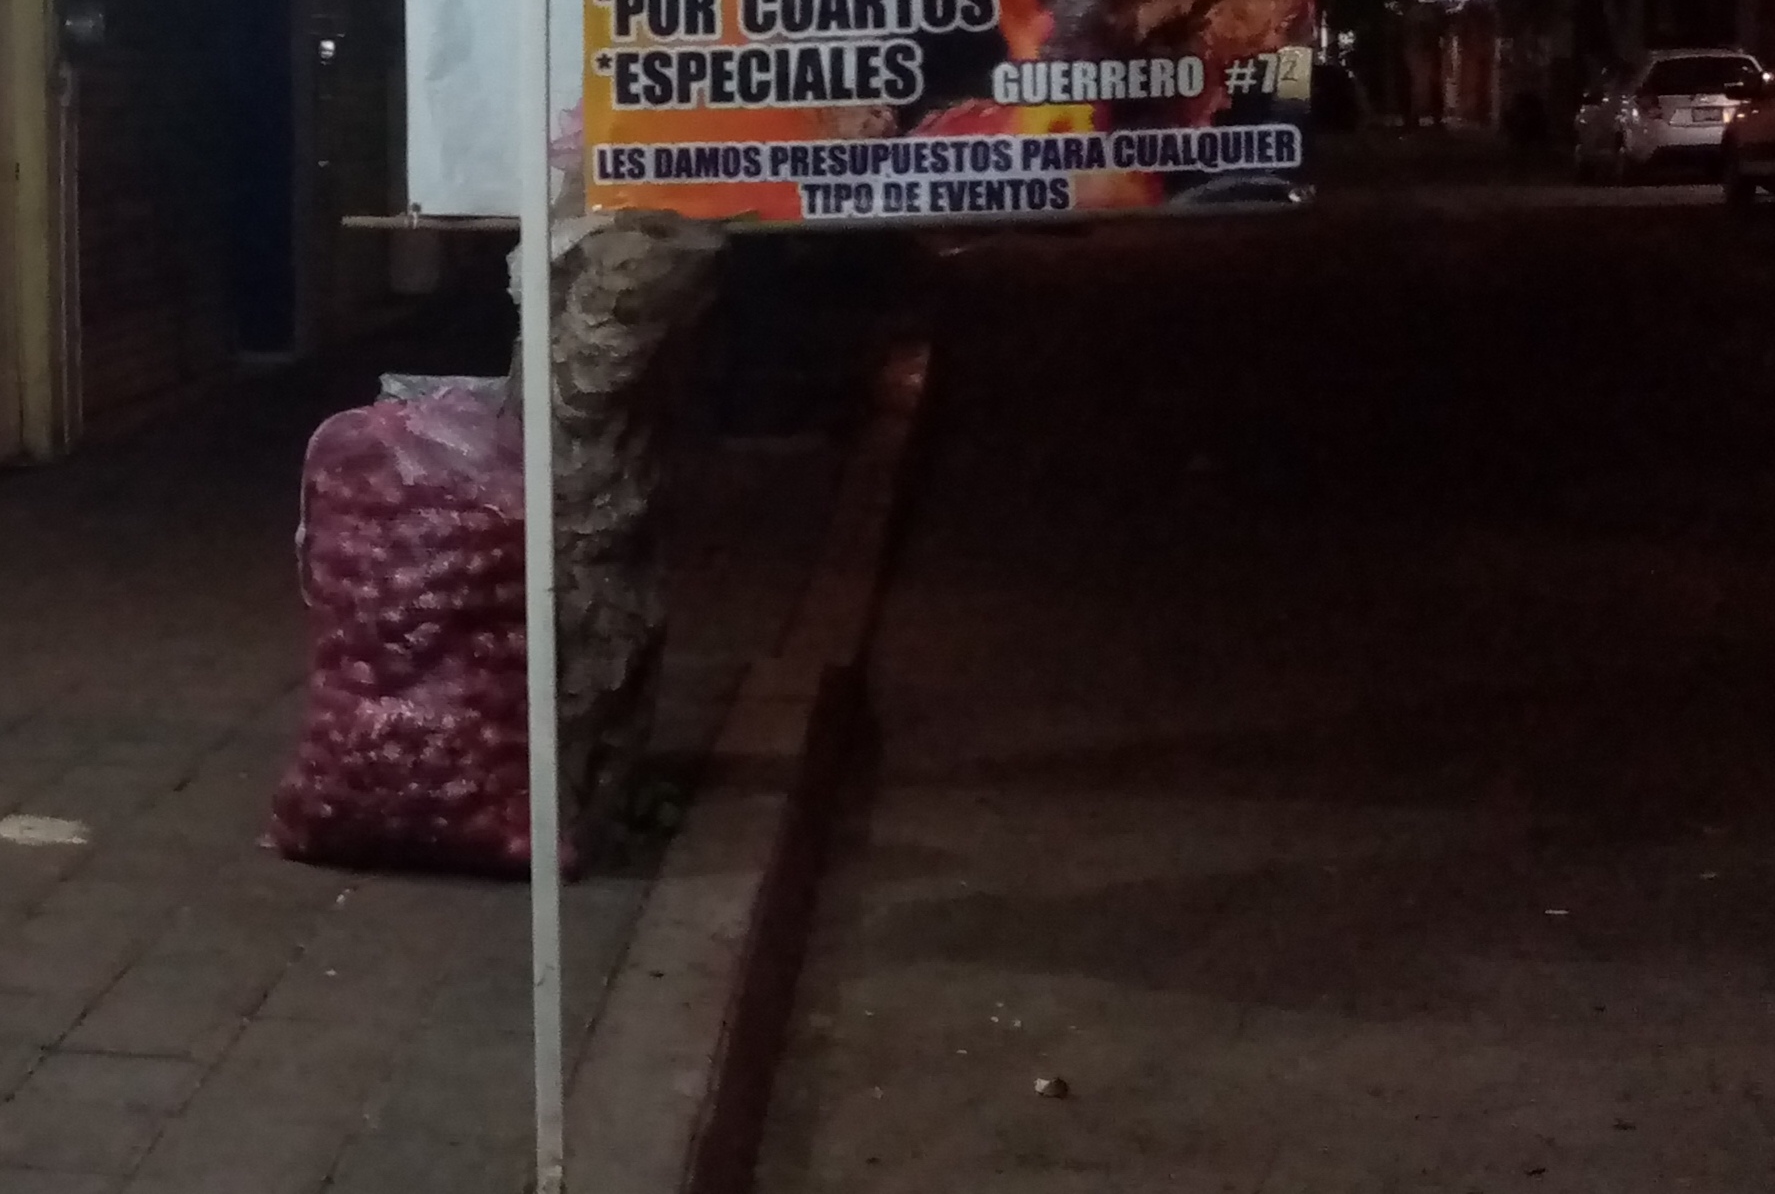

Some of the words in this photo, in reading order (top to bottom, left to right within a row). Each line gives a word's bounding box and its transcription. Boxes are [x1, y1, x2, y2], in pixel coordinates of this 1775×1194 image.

[992, 54, 1205, 105] GUERRERO
[597, 146, 646, 180] LES
[653, 143, 762, 179] DAMOS
[769, 138, 1014, 177] PRESUPUESTOS
[1023, 135, 1107, 171] PARA
[1112, 128, 1297, 169] CUALQUIER
[802, 182, 874, 214] TIPO
[882, 180, 921, 213] DE
[928, 176, 1071, 213] EVENTOS
